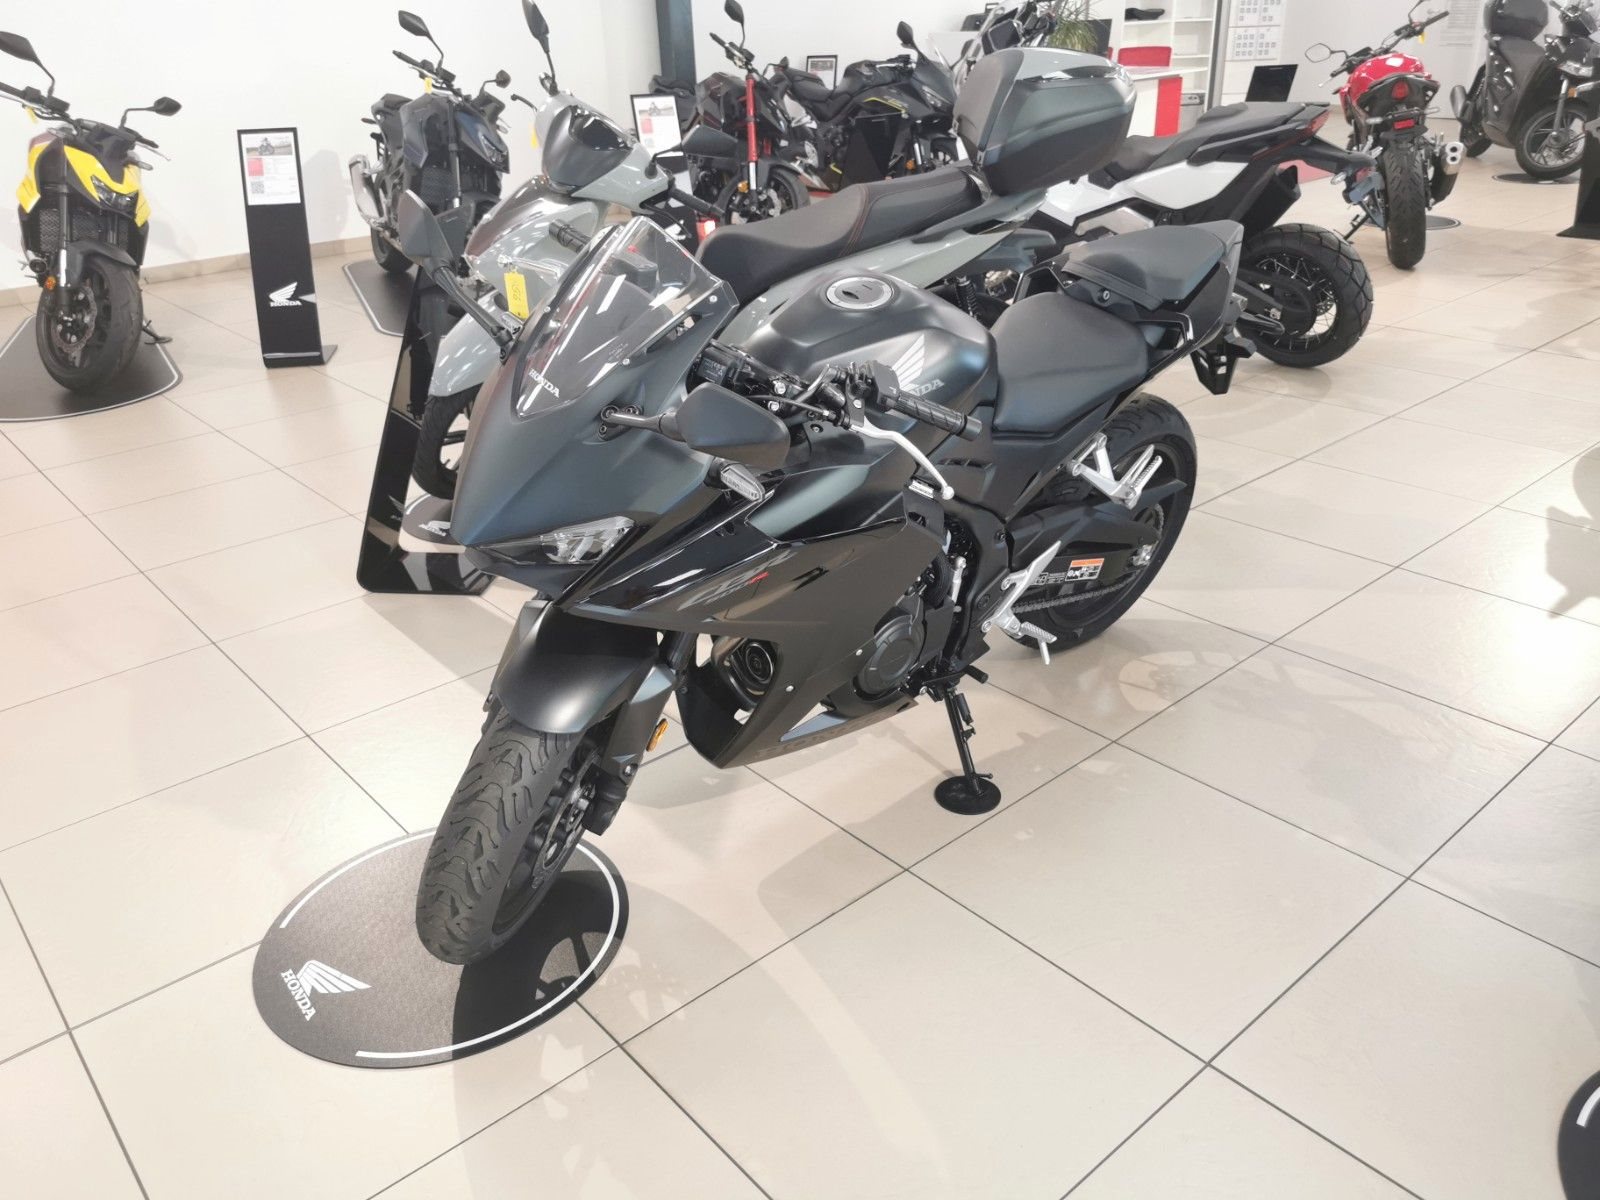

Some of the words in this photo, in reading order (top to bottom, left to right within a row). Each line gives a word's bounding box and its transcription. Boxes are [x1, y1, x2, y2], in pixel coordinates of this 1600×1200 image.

[269, 300, 303, 308] HONDA
[529, 368, 560, 399] HONDA
[280, 968, 316, 1021] HONDA
